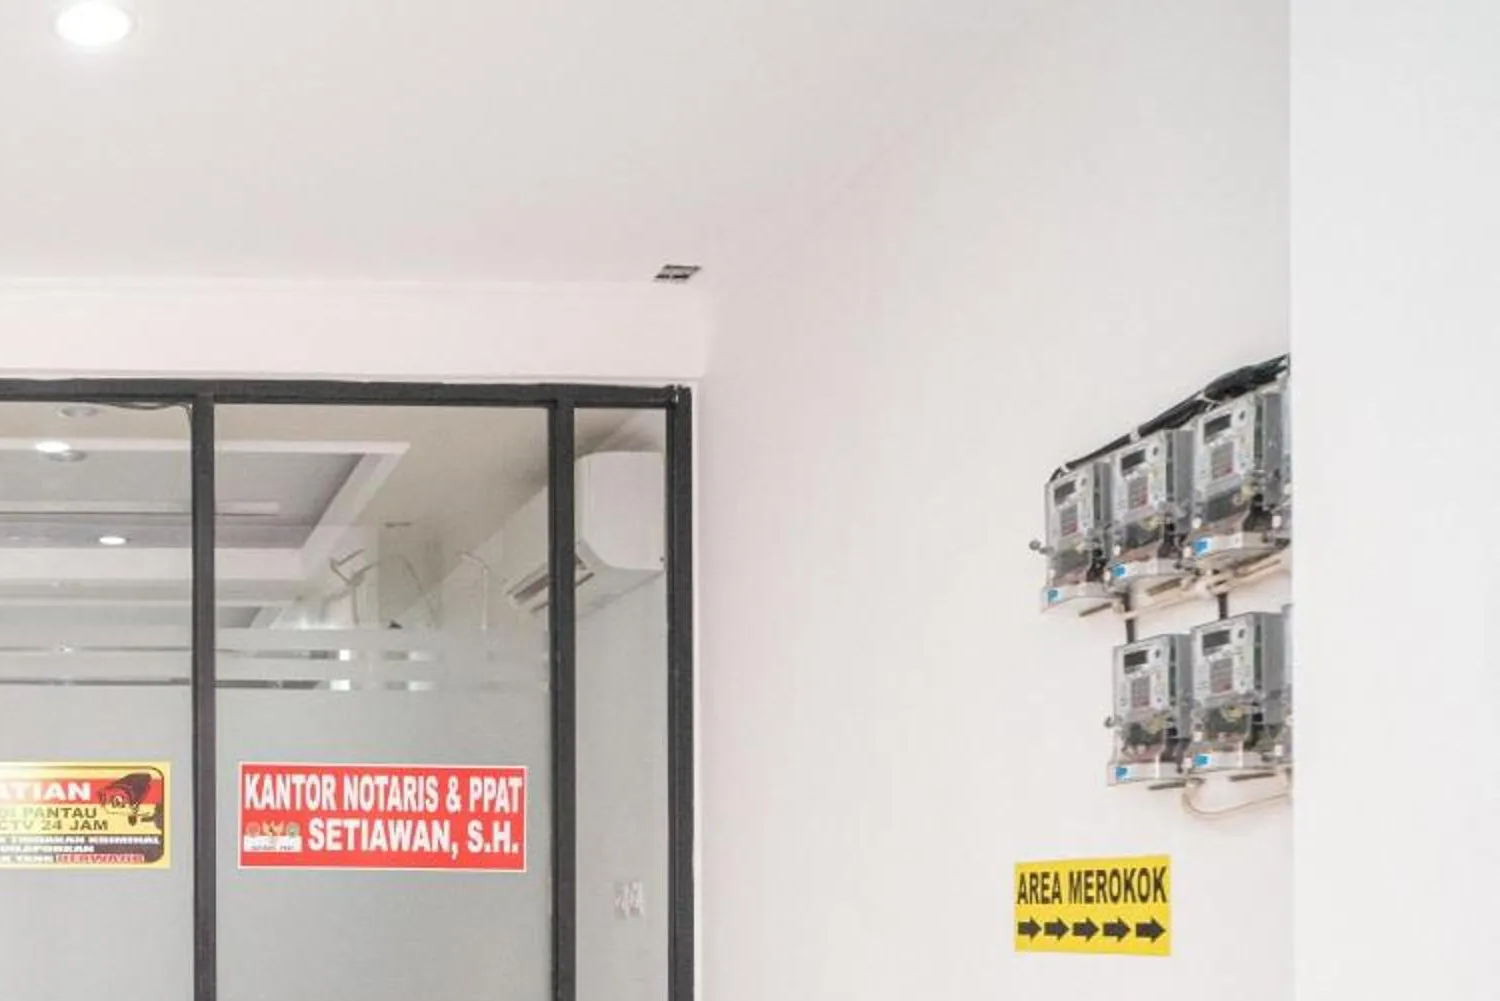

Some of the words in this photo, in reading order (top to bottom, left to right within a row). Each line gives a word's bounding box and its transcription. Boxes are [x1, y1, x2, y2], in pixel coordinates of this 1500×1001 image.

[245, 773, 337, 811] KANTOR
[343, 774, 439, 813] NOTARIS
[445, 776, 461, 813] &
[469, 776, 522, 813] PPAT
[21, 807, 97, 818] PANTAU
[41, 820, 62, 831] 24
[69, 820, 108, 831] JAM
[308, 817, 458, 860] SETIAWAN,
[467, 820, 519, 853] S.H.
[1017, 871, 1062, 904] AREA
[1068, 866, 1167, 904] MEROKOK
